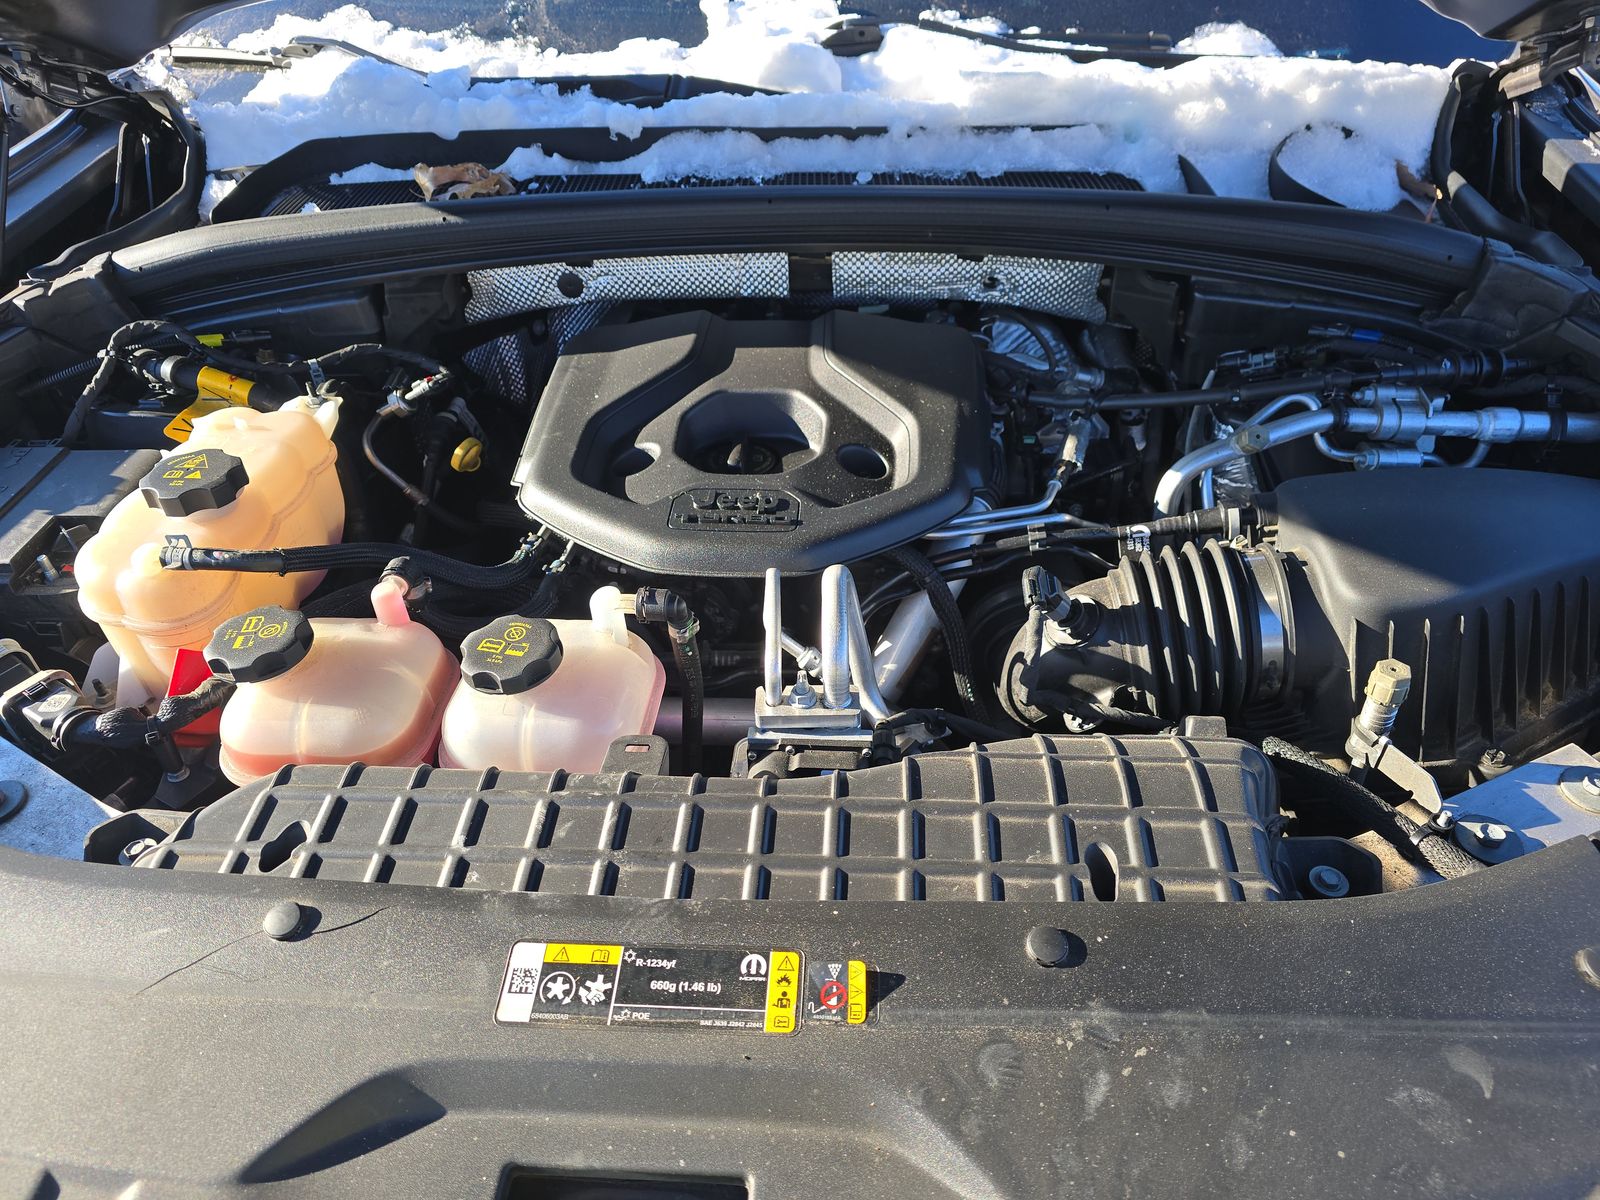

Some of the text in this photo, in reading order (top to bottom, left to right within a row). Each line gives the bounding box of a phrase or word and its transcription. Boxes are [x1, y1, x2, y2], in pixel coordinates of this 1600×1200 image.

[690, 489, 781, 513] Jeep
[635, 958, 677, 969] R-1234yf
[650, 981, 722, 994] 660g (1.46 lb)
[632, 1012, 651, 1020] POE
